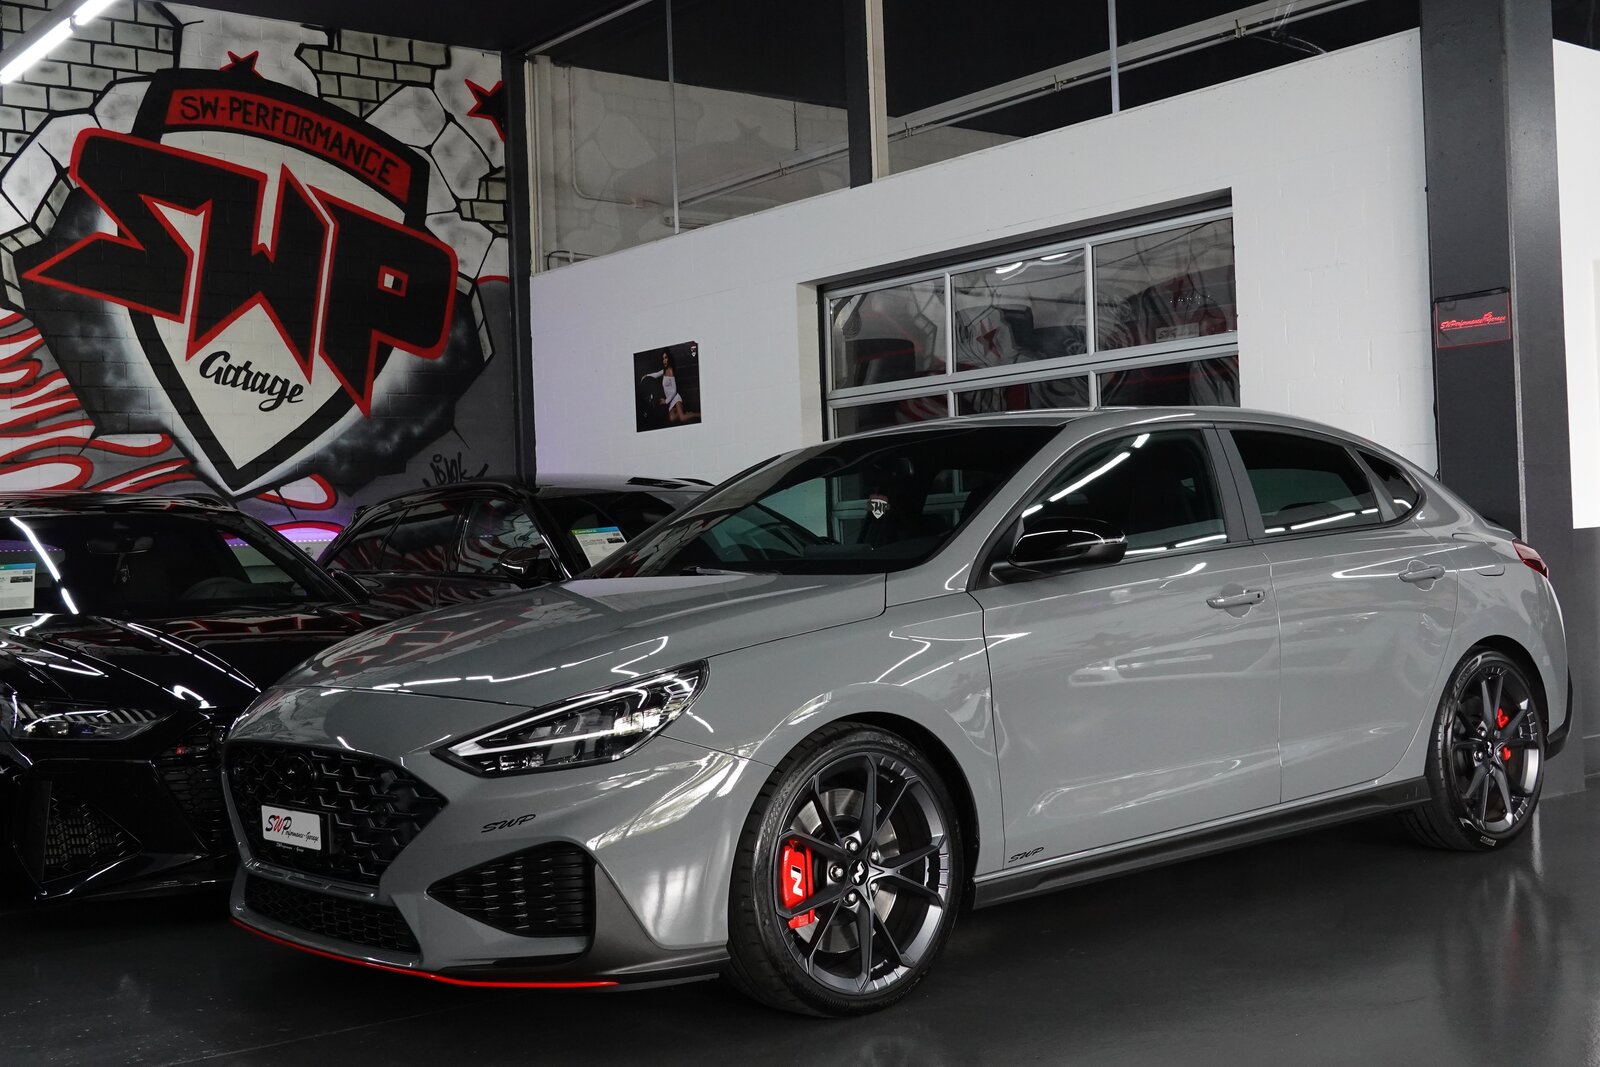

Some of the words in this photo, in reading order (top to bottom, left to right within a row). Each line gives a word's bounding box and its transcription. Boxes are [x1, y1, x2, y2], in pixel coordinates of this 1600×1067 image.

[180, 96, 398, 186] SW-PERFORMANCE
[22, 127, 459, 418] SWP
[199, 350, 304, 412] Garage
[481, 814, 537, 833] SWP
[1008, 846, 1045, 863] SWP
